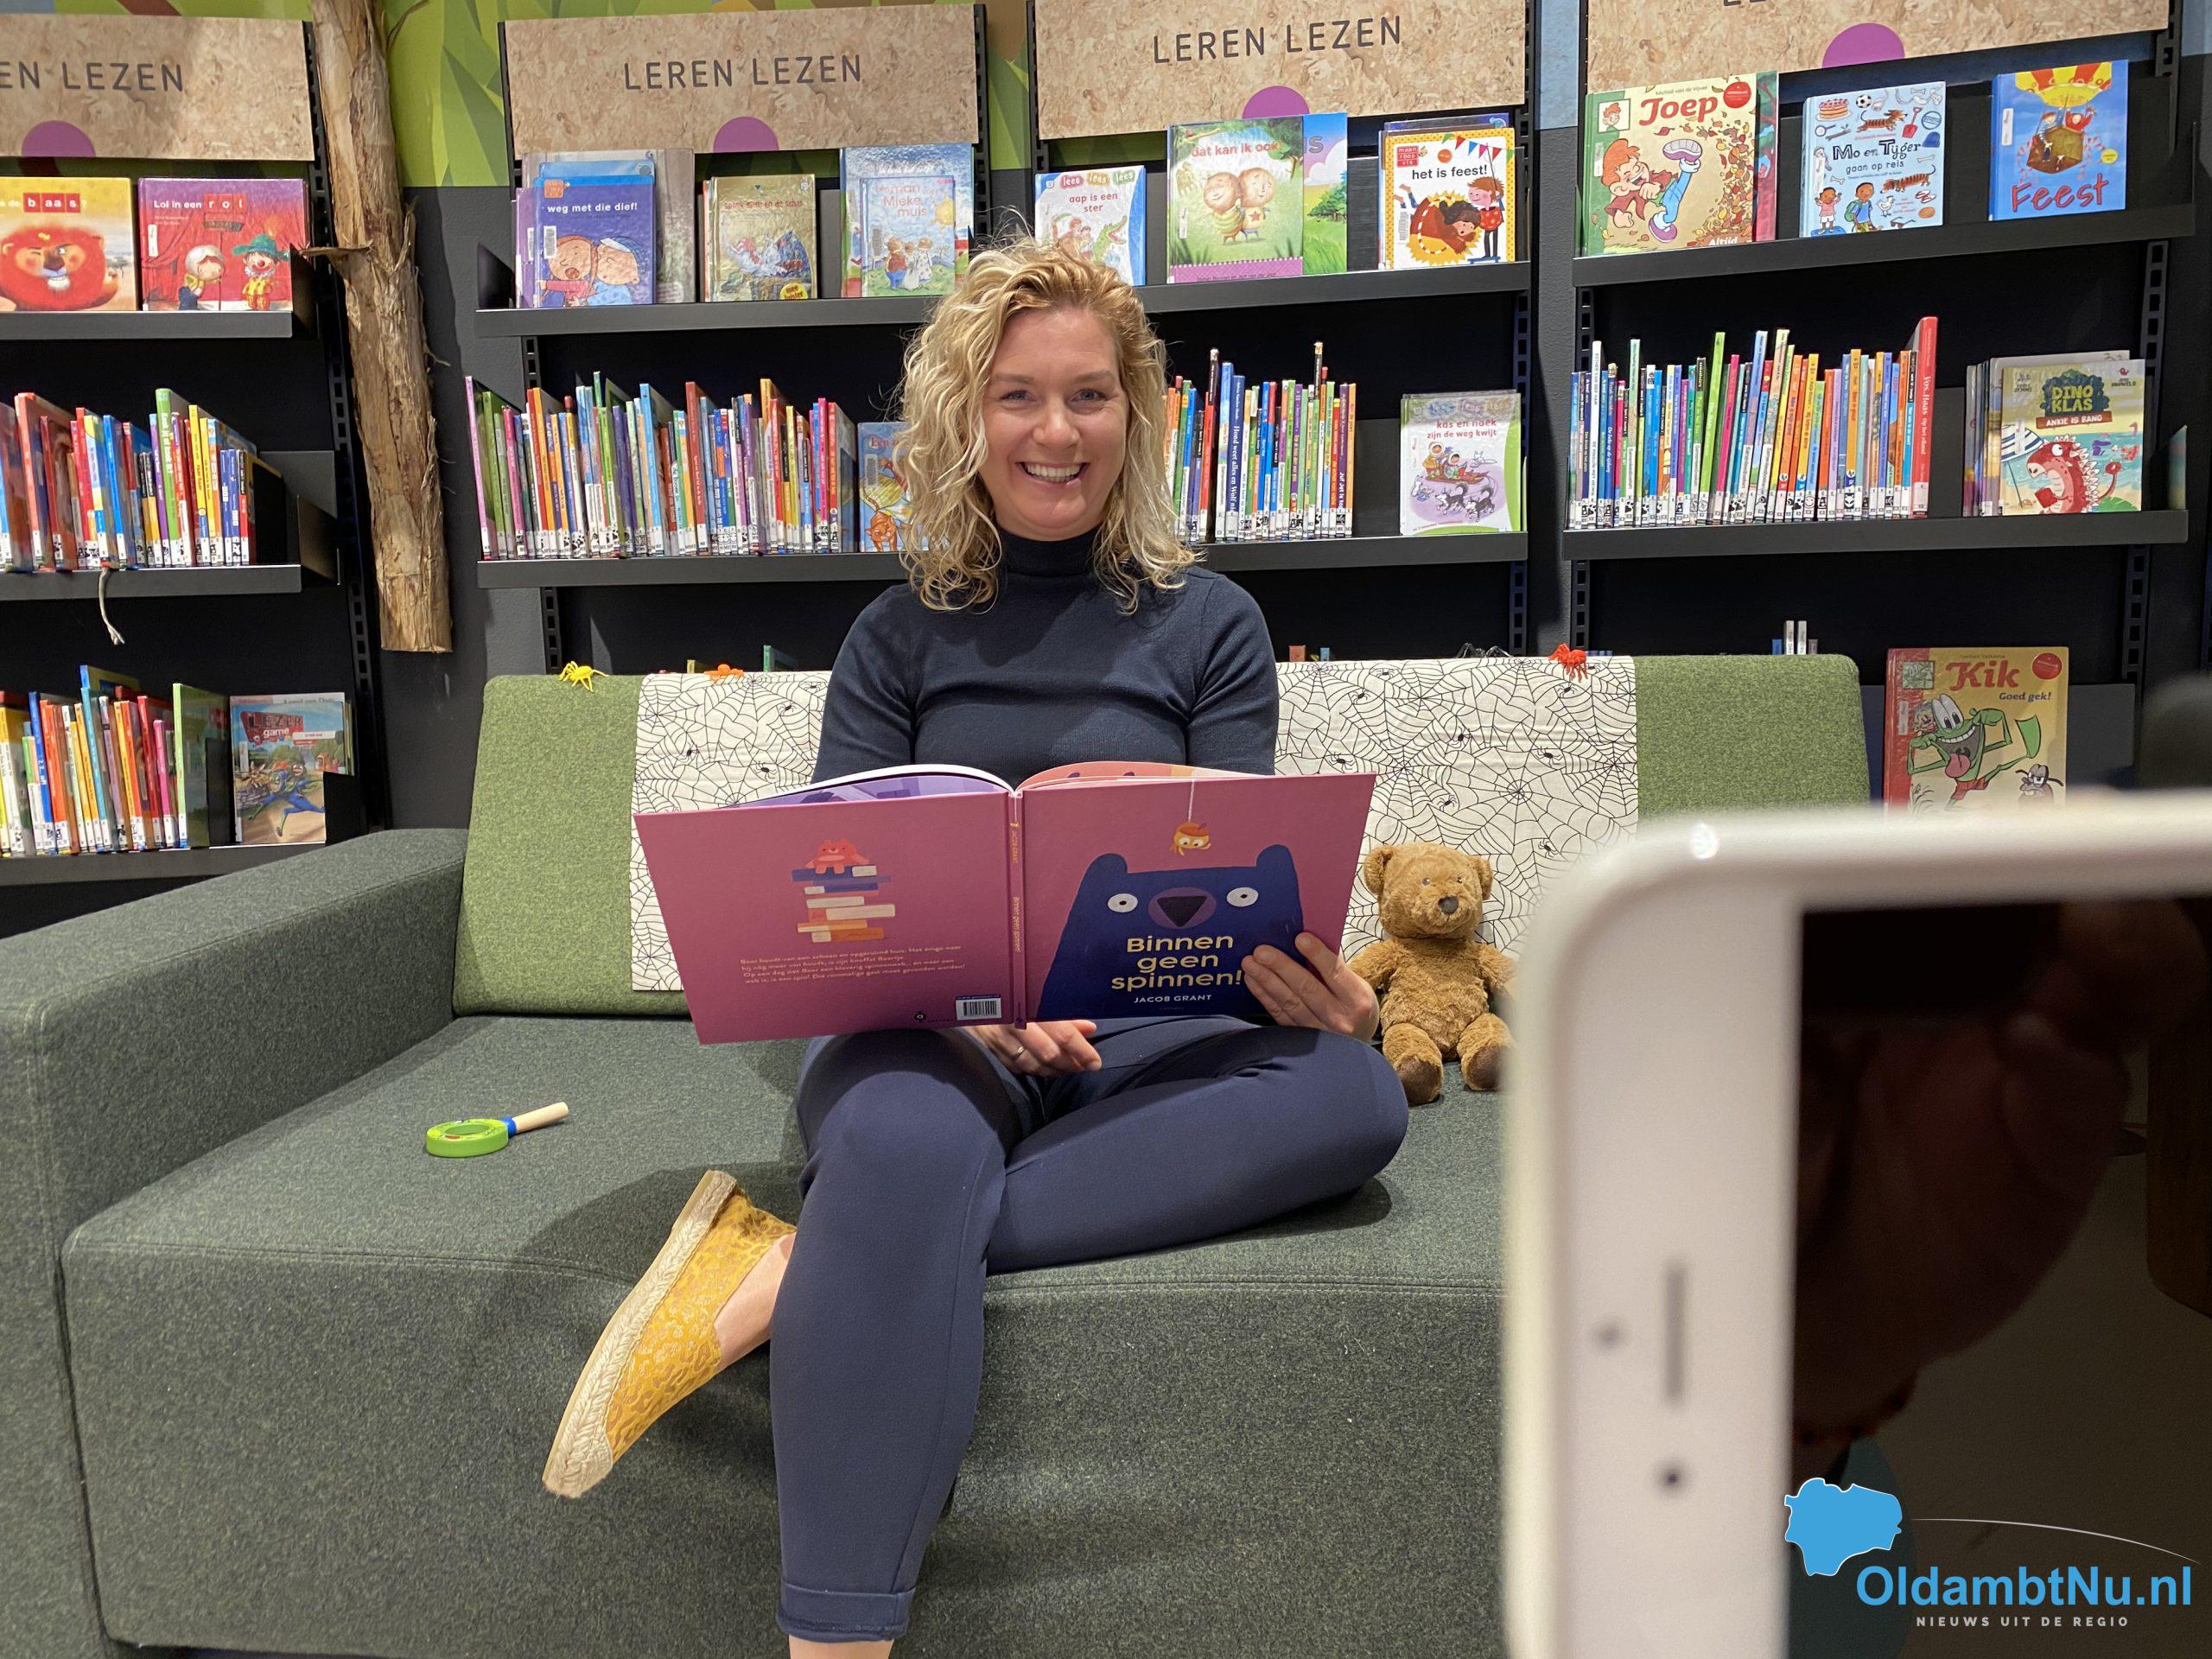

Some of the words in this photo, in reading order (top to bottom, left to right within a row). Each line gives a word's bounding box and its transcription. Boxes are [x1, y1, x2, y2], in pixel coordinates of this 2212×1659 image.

[1154, 28, 1265, 64] LEREN
[1287, 16, 1401, 52] LEZEN
[62, 61, 183, 92] LEZEN
[624, 60, 733, 90] LEREN
[753, 54, 861, 86] LEZEN
[1639, 97, 1718, 126] Joep
[1192, 148, 1211, 157] dat
[1215, 145, 1237, 155] kan
[1241, 143, 1252, 153] ik
[1833, 144, 1860, 161] Mo
[1412, 169, 1433, 180] het
[1436, 168, 1447, 178] is
[1452, 164, 1487, 177] feest!
[1846, 164, 1868, 175] gaan
[1872, 163, 1883, 173] op
[1063, 175, 1080, 186] lees
[1116, 171, 1134, 182] lees
[2011, 173, 2109, 213] Feest
[154, 200, 169, 208] Lol
[172, 200, 181, 208] in
[208, 199, 244, 208] rol
[547, 205, 569, 213] weg
[594, 203, 611, 212] die
[614, 202, 638, 211] dief!
[884, 196, 922, 207] Mieke
[898, 207, 927, 217] muis
[1084, 205, 1103, 213] ster
[1709, 237, 1738, 246] Altijd
[1923, 375, 1931, 391] Vos
[2051, 386, 2094, 400] DINO
[1921, 394, 1930, 415] Haas
[2051, 399, 2093, 413] KLAS
[1436, 420, 1453, 429] kas
[2046, 416, 2068, 427] ANKIE
[2082, 415, 2102, 423] BANG
[1427, 431, 1442, 440] zijn
[1457, 430, 1473, 439] weg
[1476, 429, 1497, 438] kwijt
[1229, 486, 1237, 501] Wolf
[1945, 659, 2021, 691] Kik
[1999, 692, 2026, 701] Goed
[2027, 692, 2051, 702] gek!
[264, 728, 289, 738] game
[1127, 936, 1234, 953] Binnen
[1137, 955, 1218, 974] geen
[1111, 969, 1243, 992] spinnen!
